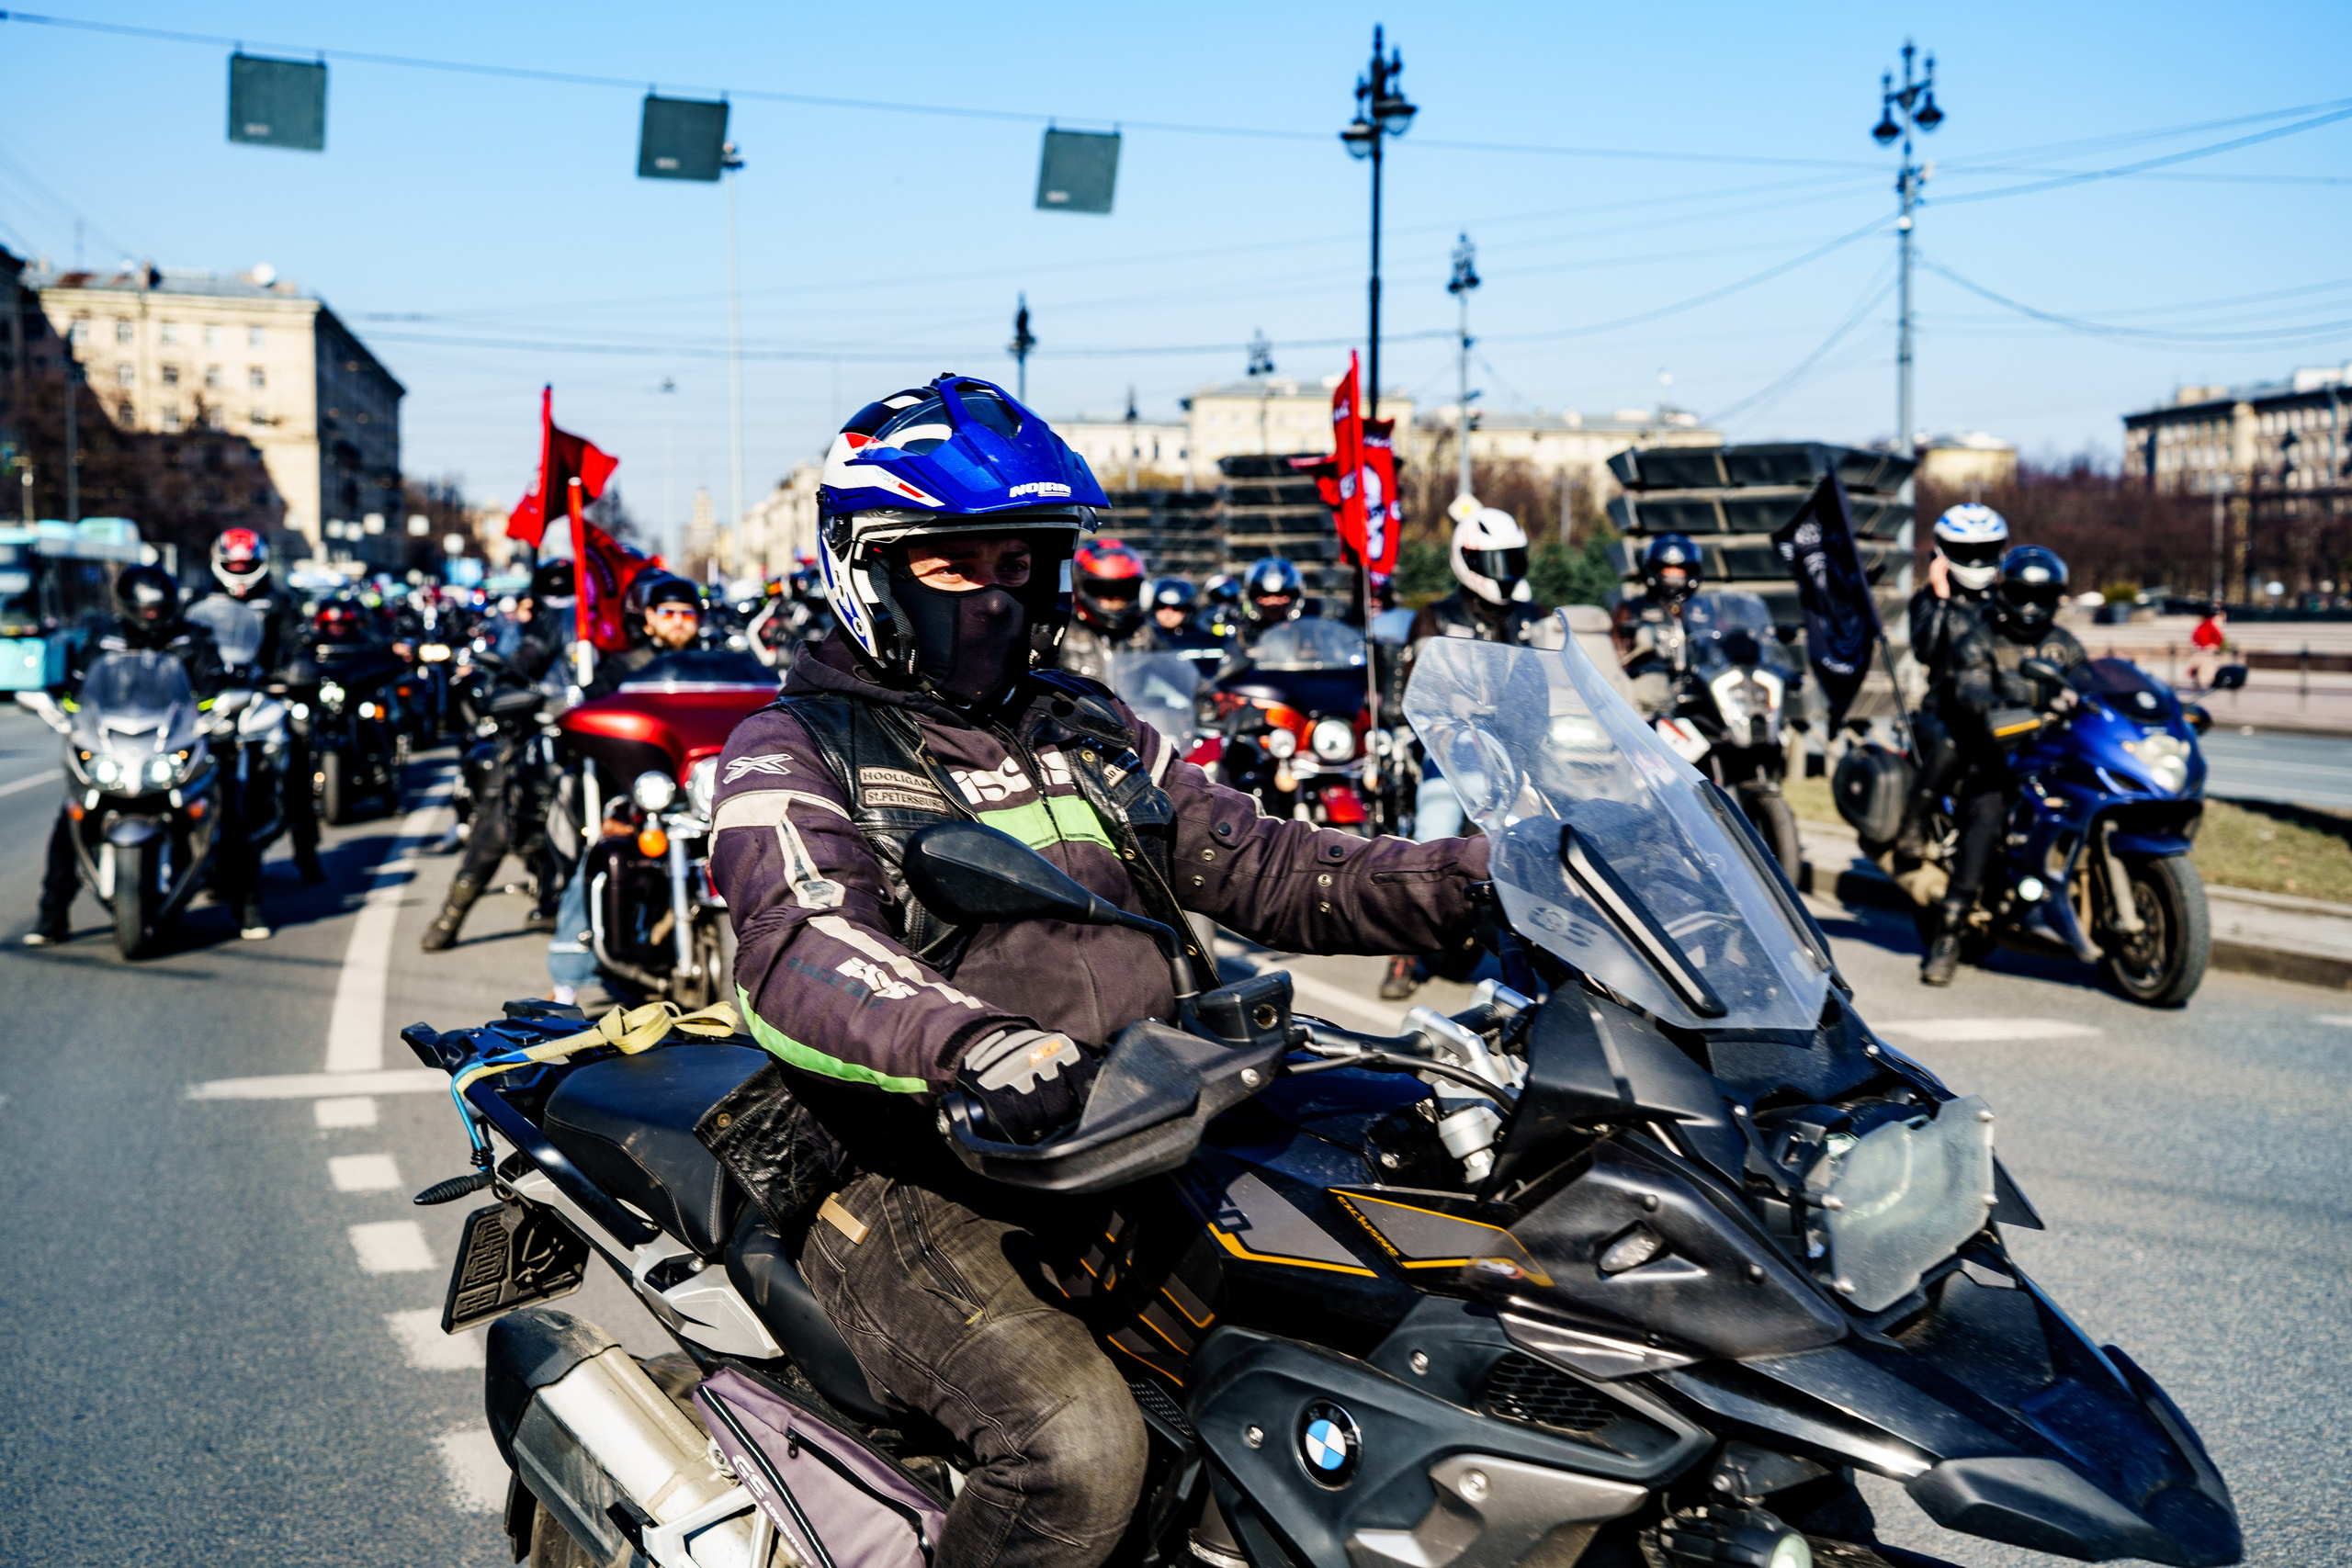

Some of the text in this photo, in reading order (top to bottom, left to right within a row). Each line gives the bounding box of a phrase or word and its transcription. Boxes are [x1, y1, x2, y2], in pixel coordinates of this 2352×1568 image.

[1009, 481, 1071, 498] NOLAN
[863, 772, 937, 791] HOOLIGANS
[1337, 1195, 1400, 1258] exclusive
[732, 1454, 770, 1500] GS
